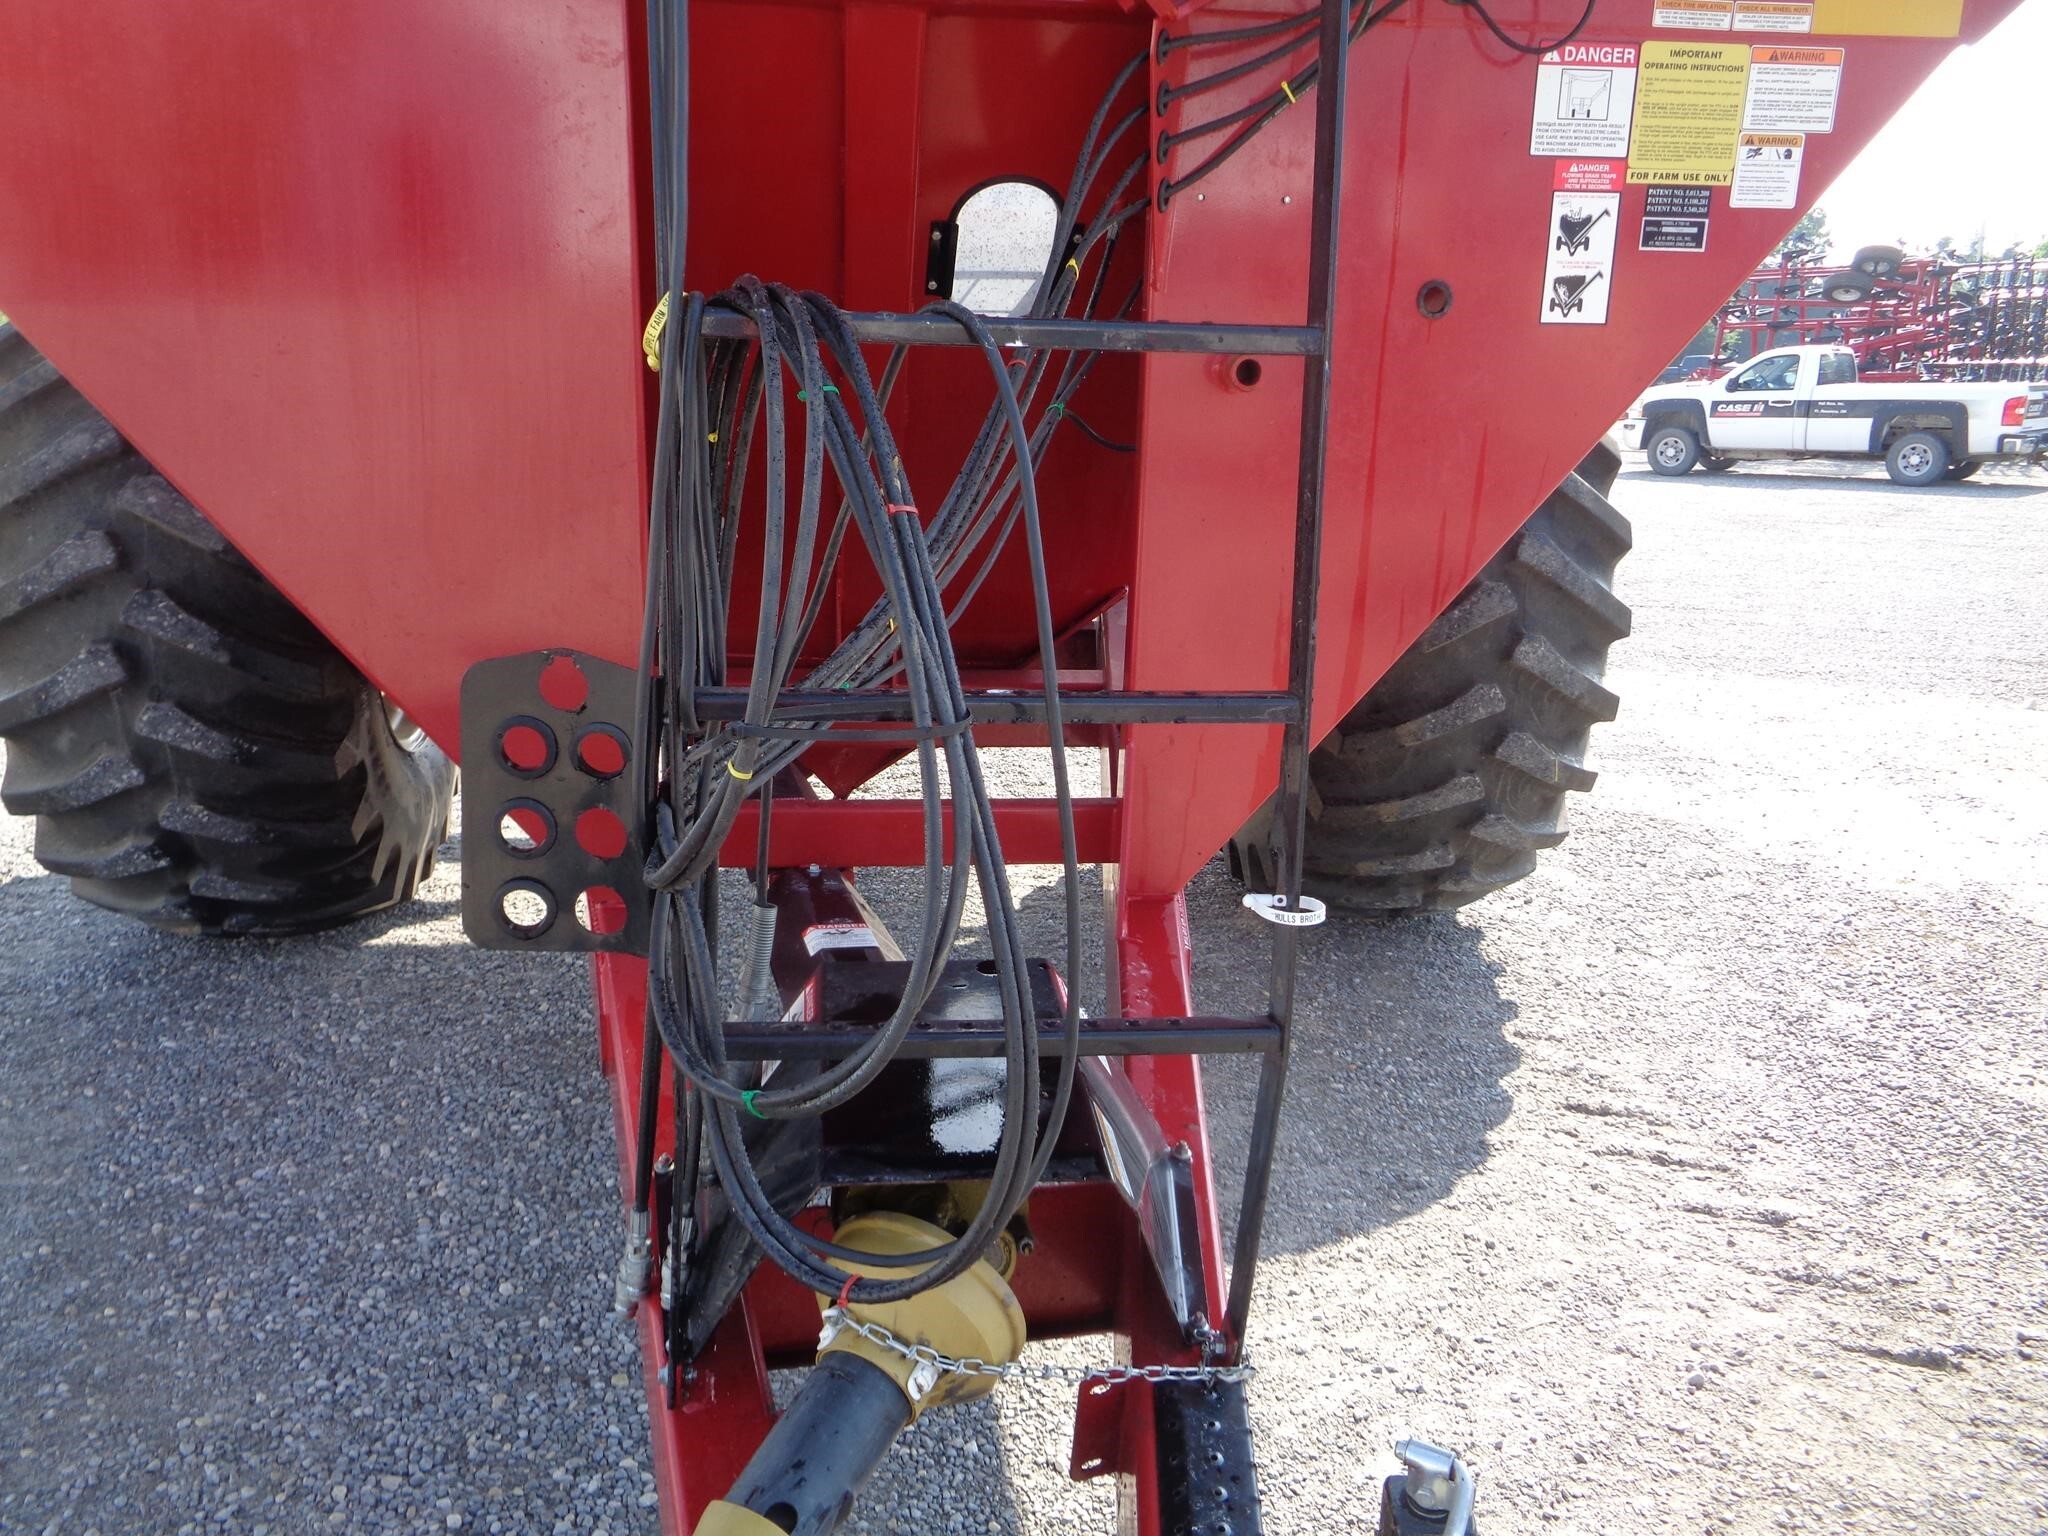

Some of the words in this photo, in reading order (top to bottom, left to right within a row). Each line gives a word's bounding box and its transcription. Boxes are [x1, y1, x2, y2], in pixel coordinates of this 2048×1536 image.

[1564, 46, 1635, 64] DANGER
[1670, 49, 1723, 59] IMPORTANT
[1780, 50, 1825, 62] WARNING
[1644, 62, 1688, 71] OPERATING
[1690, 64, 1744, 73] INSTRUCTIONS
[1758, 136, 1798, 146] WARNING
[1578, 164, 1609, 172] DANGER
[1630, 171, 1649, 180] FOR
[1652, 172, 1679, 181] FARM
[1683, 173, 1700, 182] USE
[1704, 174, 1728, 182] ONLY
[650, 309, 666, 331] FARM
[1717, 404, 1751, 412] CASE
